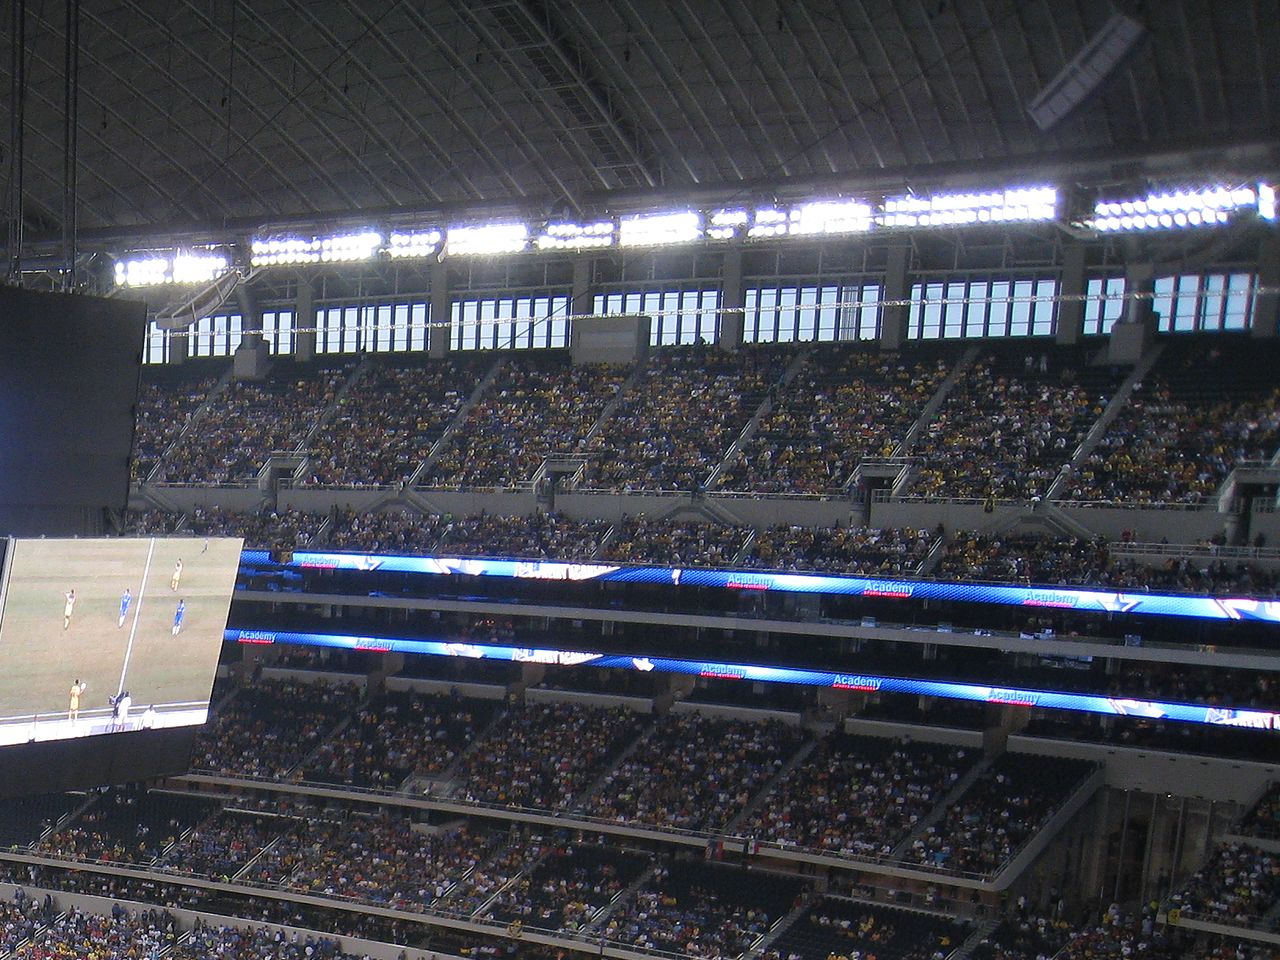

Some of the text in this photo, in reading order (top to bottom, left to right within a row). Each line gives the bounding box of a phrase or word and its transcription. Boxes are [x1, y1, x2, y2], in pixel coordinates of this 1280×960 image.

[728, 574, 775, 588] Academy
[864, 581, 914, 597] Academy
[239, 630, 277, 643] Academy
[701, 663, 746, 679] Academy
[833, 674, 882, 690] Academy
[988, 688, 1040, 705] Academy
